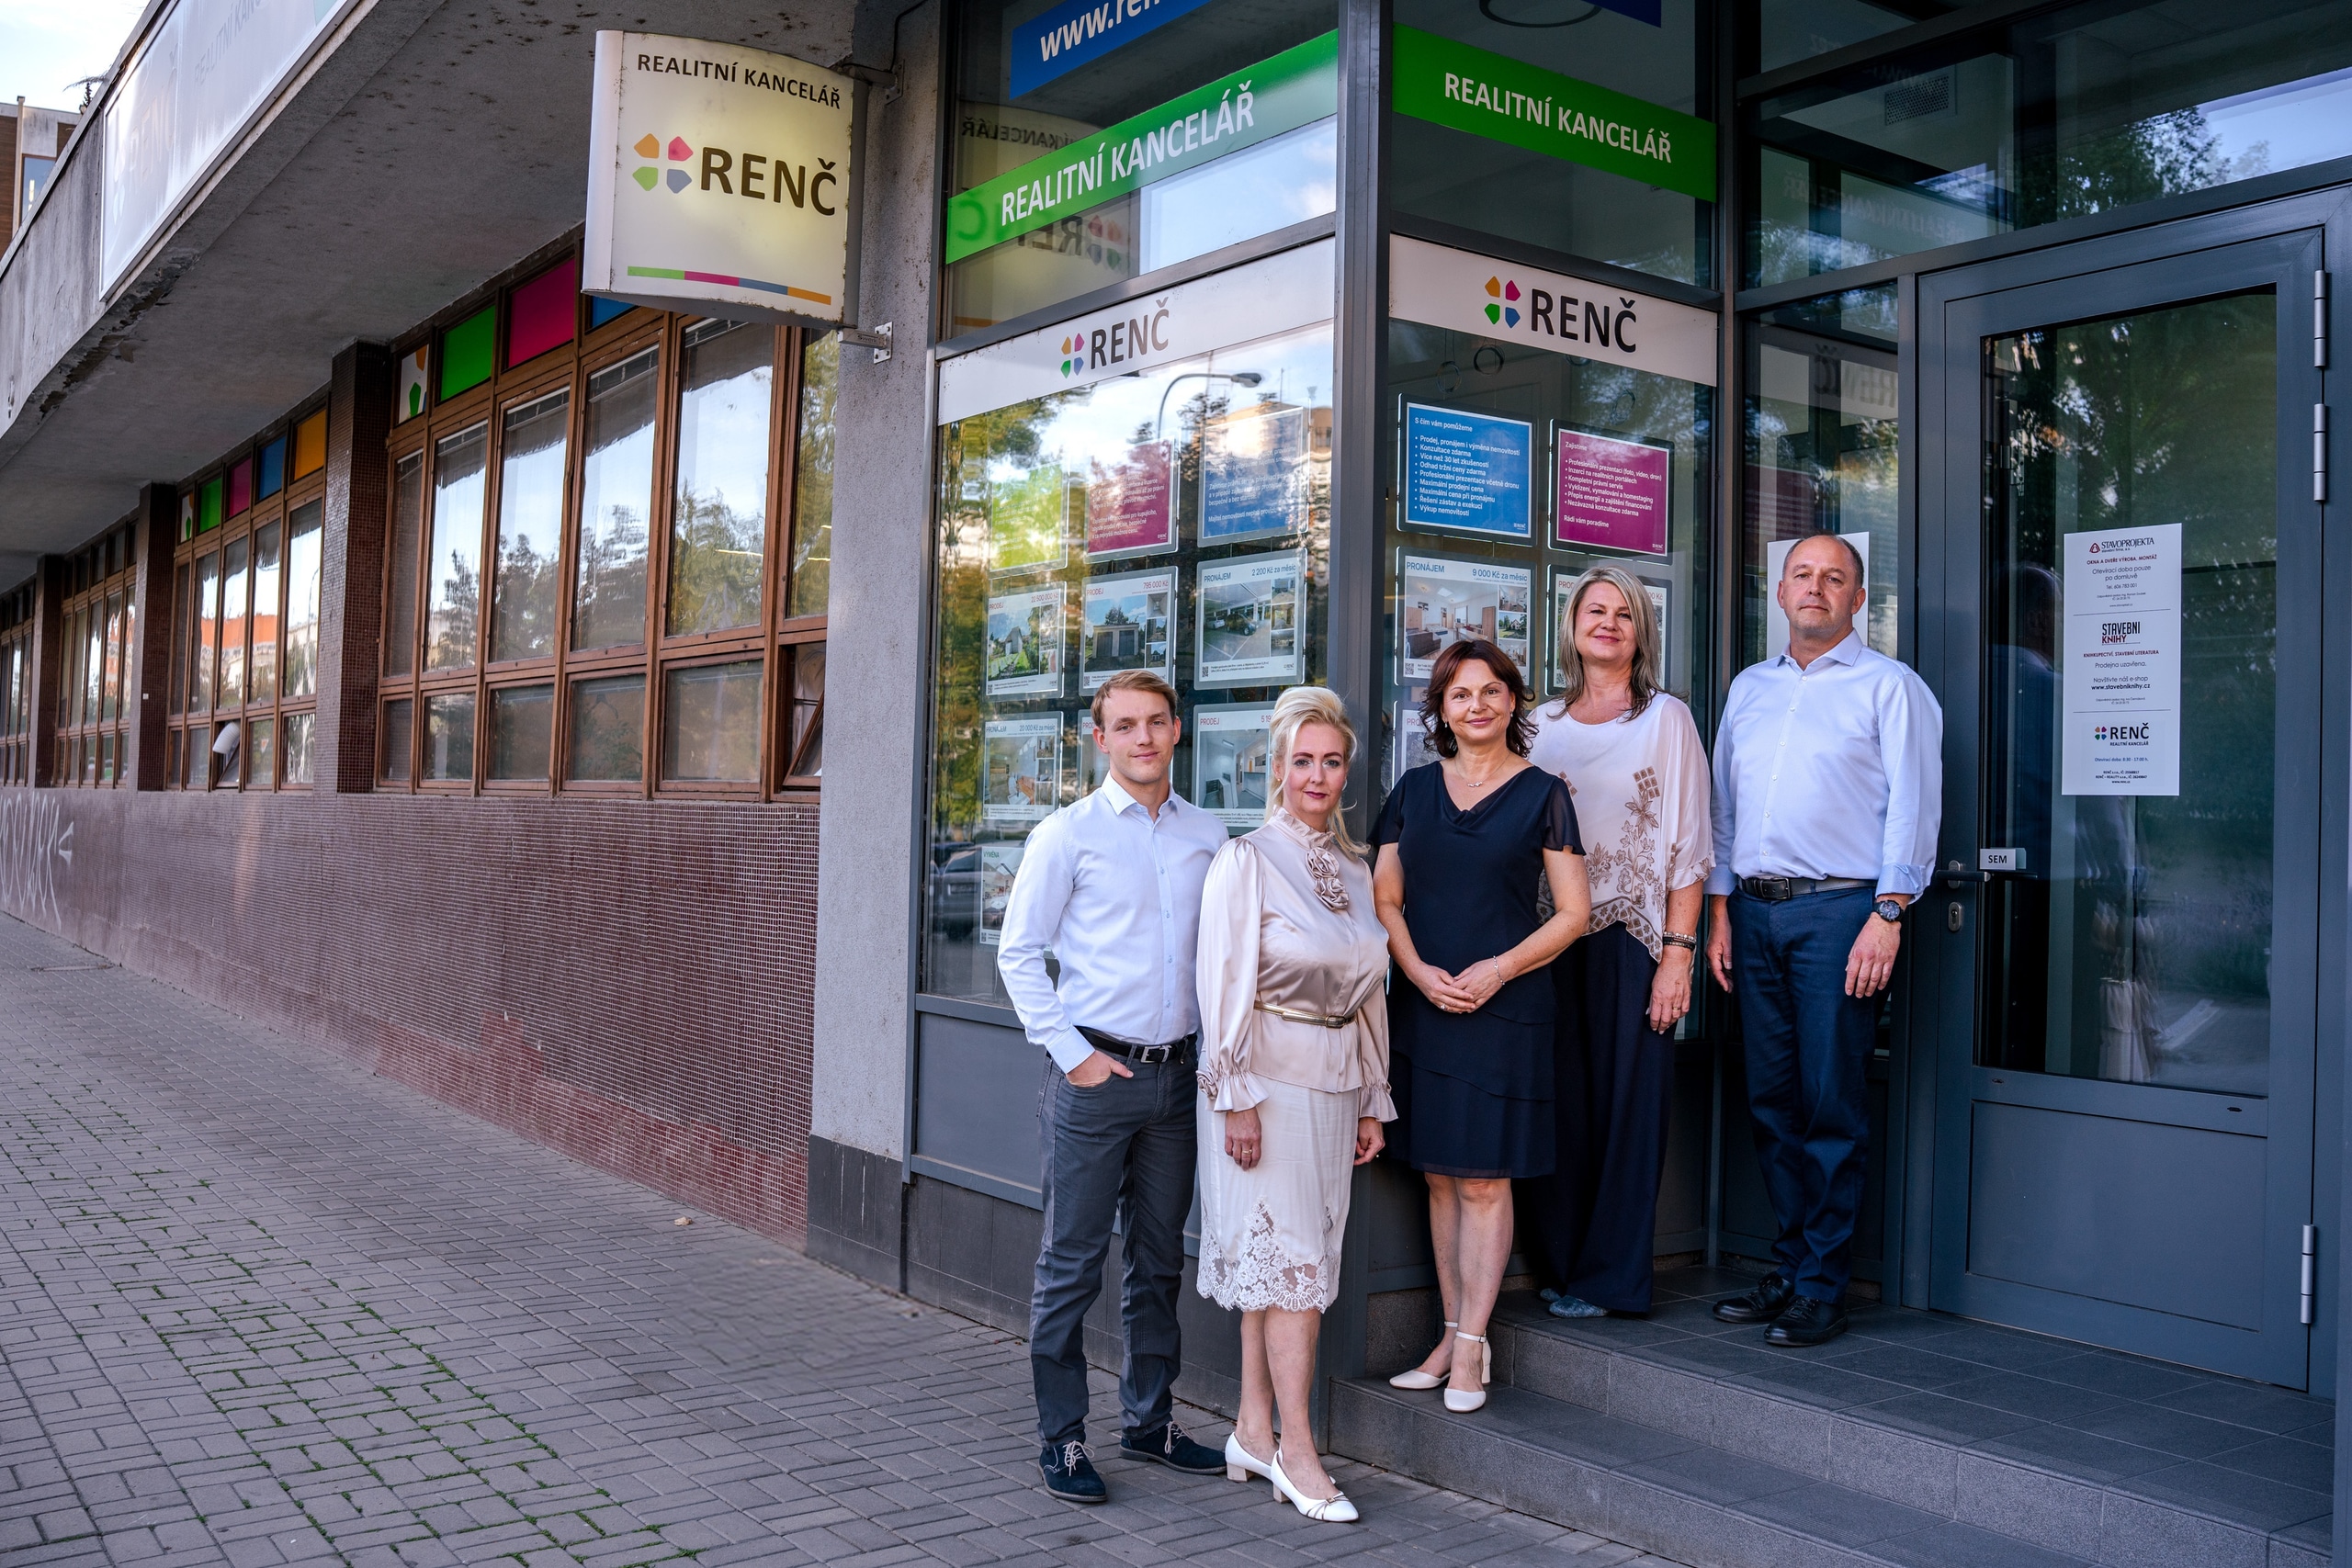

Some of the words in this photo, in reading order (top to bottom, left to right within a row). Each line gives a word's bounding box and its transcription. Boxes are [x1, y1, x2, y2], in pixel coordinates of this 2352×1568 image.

[638, 54, 737, 83] REALITNÍ
[744, 67, 841, 109] KANCELÁŘ
[1445, 73, 1552, 128] REALITNÍ
[1558, 107, 1671, 164] KANCELÁŘ
[1001, 142, 1107, 226] REALITNÍ
[1111, 80, 1254, 182] KANCELÁŘ
[700, 146, 837, 216] RENČ
[1532, 288, 1636, 354] RENČ
[1091, 297, 1169, 369] RENČ
[1431, 420, 1442, 428] vám
[1443, 423, 1473, 432] pomůžeme
[1420, 435, 1439, 445] Prodej,
[1441, 439, 1465, 447] pronájem
[1469, 443, 1489, 451] výměna
[1420, 444, 1450, 454] Konzultace
[1566, 442, 1588, 451] Zajistíme
[1433, 454, 1443, 462] než
[1461, 458, 1489, 468] zkušeností
[1466, 468, 1486, 476] zdarma
[1568, 458, 1599, 469] Profesionální
[1600, 465, 1623, 474] prezentaci
[1623, 468, 1635, 476] (foto,
[1650, 473, 1662, 481] dron)
[1568, 467, 1585, 475] Inzerci
[1592, 471, 1613, 479] realitních
[1615, 476, 1637, 484] portálech
[1419, 479, 1447, 488] Maximální
[1448, 482, 1470, 491] prodejní
[1420, 470, 1454, 480] Profesionální
[1456, 476, 1485, 484] prezentace
[1486, 478, 1503, 487] včetně
[1568, 475, 1592, 484] Kompletní
[1419, 488, 1447, 496] Maximální
[1471, 494, 1495, 502] pronájmu
[1568, 483, 1591, 493] Vyklízení,
[1592, 488, 1619, 497] vymalování
[1623, 492, 1653, 503] homestaging
[1419, 496, 1438, 504] Řešení
[1439, 498, 1456, 506] zástav
[1462, 502, 1483, 510] exekucí
[1567, 500, 1594, 509] Nezávazná
[1595, 504, 1621, 513] konzultace
[1622, 508, 1639, 516] zdarma
[1568, 491, 1583, 500] Přepis
[1584, 494, 1600, 502] energií
[1605, 497, 1624, 506] zajištění
[1625, 501, 1652, 511] financování
[1419, 504, 1437, 513] Výkup
[1587, 519, 1609, 527] poradíme
[2101, 537, 2154, 549] STAVOPROJEKTA
[1256, 568, 1266, 576] 200
[1267, 566, 1273, 574] Kč
[1281, 564, 1295, 572] měsíc
[1407, 562, 1444, 572] PRONÁJEM
[1204, 572, 1231, 582] PRONÁJEM
[1492, 570, 1500, 579] Kč
[1510, 573, 1527, 581] měsíc
[2102, 622, 2140, 636] STAVEBNI
[2102, 635, 2126, 643] KNIHY
[2110, 723, 2149, 739] RENČ
[1988, 855, 2007, 863] SEM
